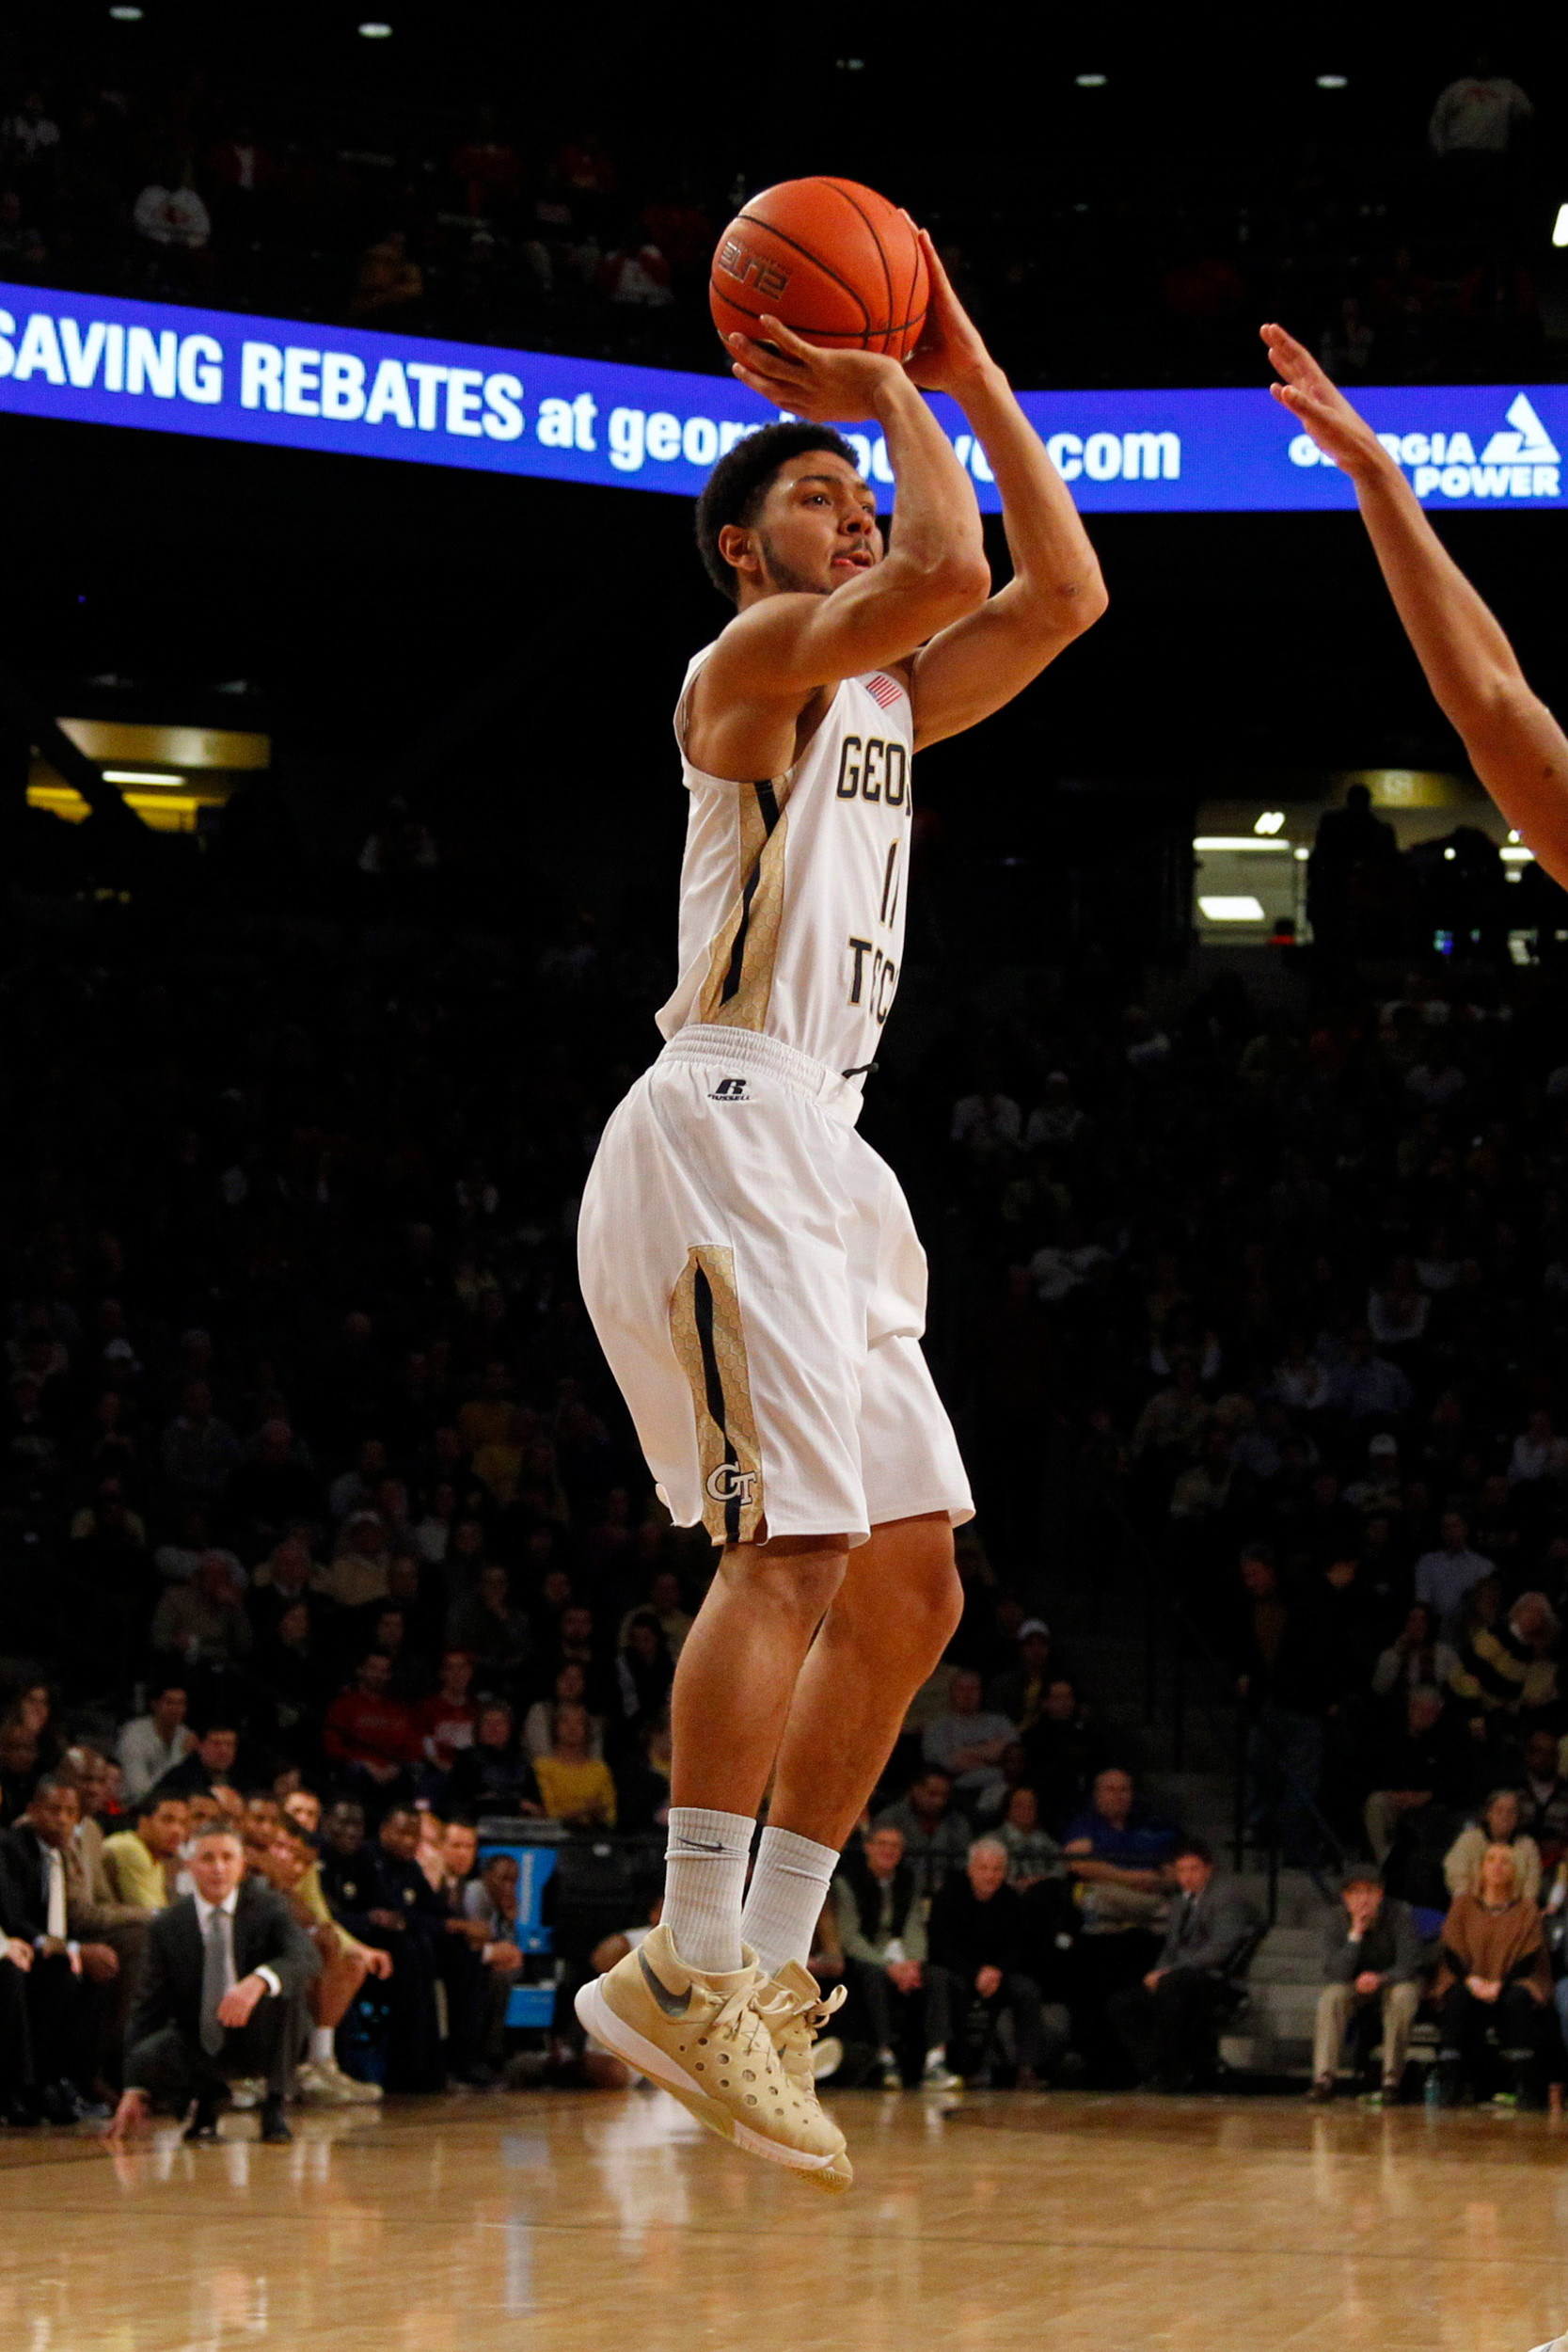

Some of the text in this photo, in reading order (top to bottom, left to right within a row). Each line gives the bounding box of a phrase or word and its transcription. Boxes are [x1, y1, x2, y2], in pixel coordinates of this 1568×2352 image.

[241, 340, 525, 441] REBATES
[536, 392, 598, 452] at
[1288, 432, 1476, 468] GRGIA
[1414, 465, 1560, 499] POWER
[835, 736, 911, 817] GEO
[706, 1461, 757, 1506] GT
